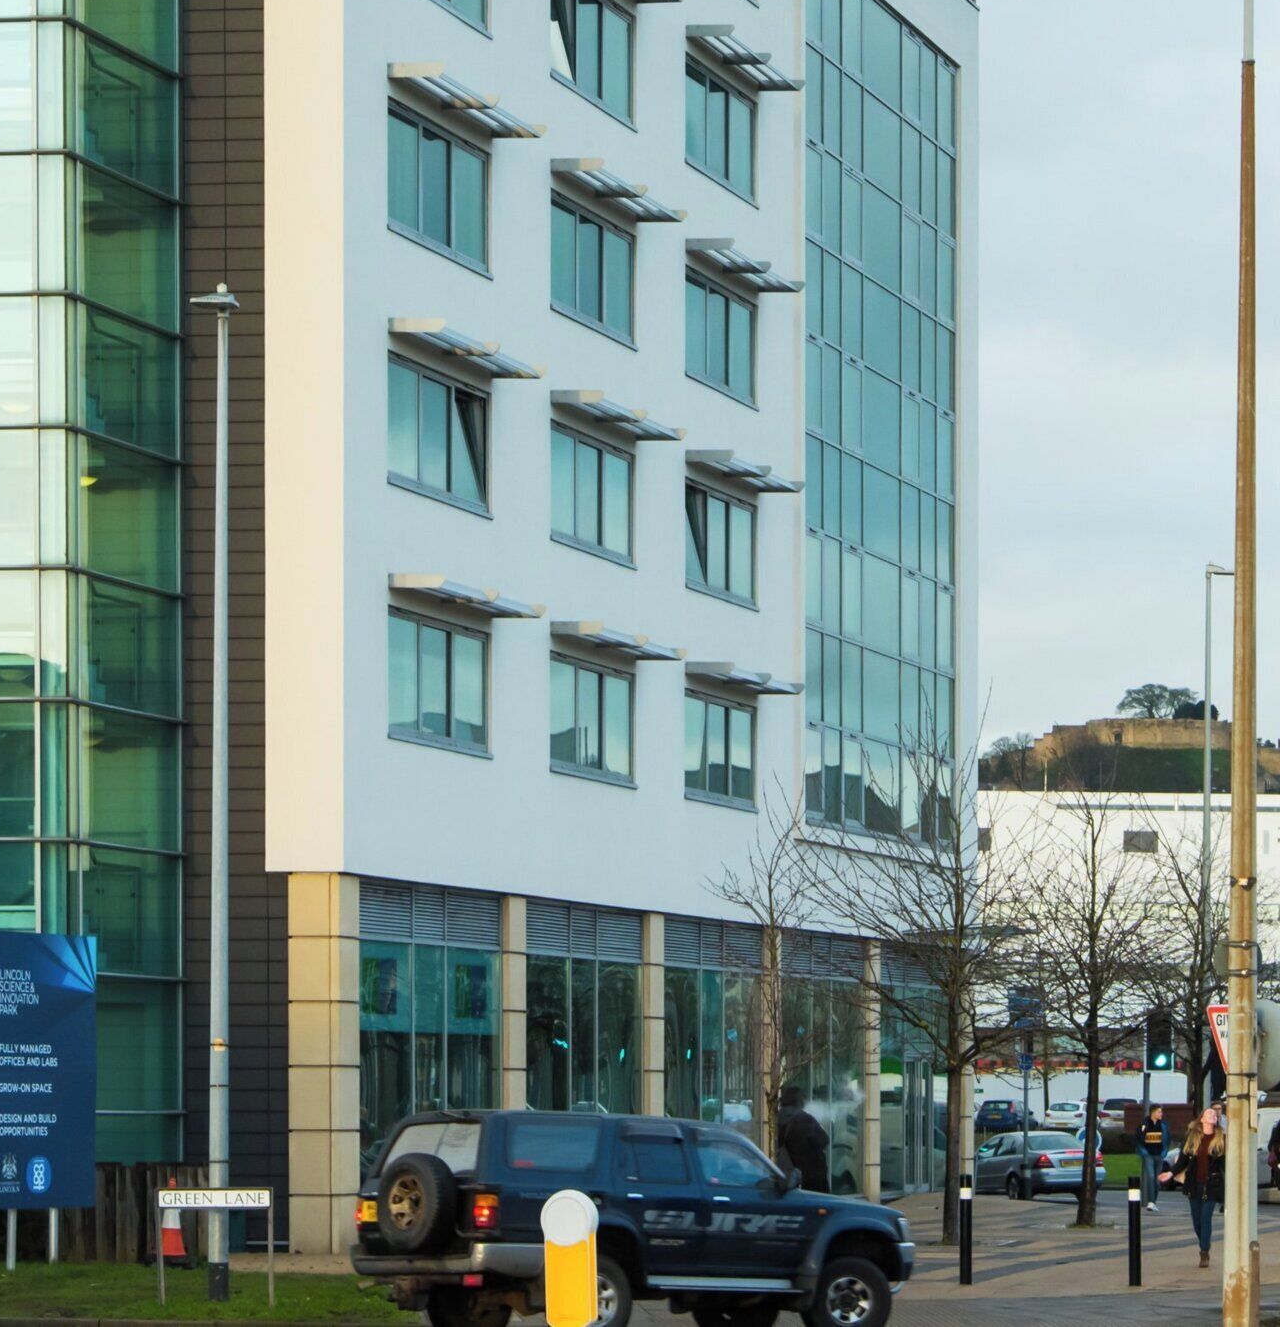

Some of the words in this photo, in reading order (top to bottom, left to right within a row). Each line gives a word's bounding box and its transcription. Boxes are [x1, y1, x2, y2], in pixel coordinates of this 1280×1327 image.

[0, 969, 31, 981] LINCOLN
[0, 981, 30, 993] SCIENCE
[0, 993, 39, 1005] INNOVATION
[0, 1004, 18, 1015] PARK
[20, 1044, 52, 1054] MANAGED
[26, 1057, 41, 1066] AND
[41, 1057, 58, 1067] LABS
[31, 1083, 53, 1093] SPACE
[0, 1113, 23, 1123] DESIGN
[23, 1114, 37, 1123] AND
[38, 1114, 57, 1124] BUILD
[0, 1126, 48, 1136] OPPORTUNITIES
[162, 1192, 213, 1205] GREEN
[224, 1192, 266, 1205] LANE
[642, 1210, 805, 1233] SURF
